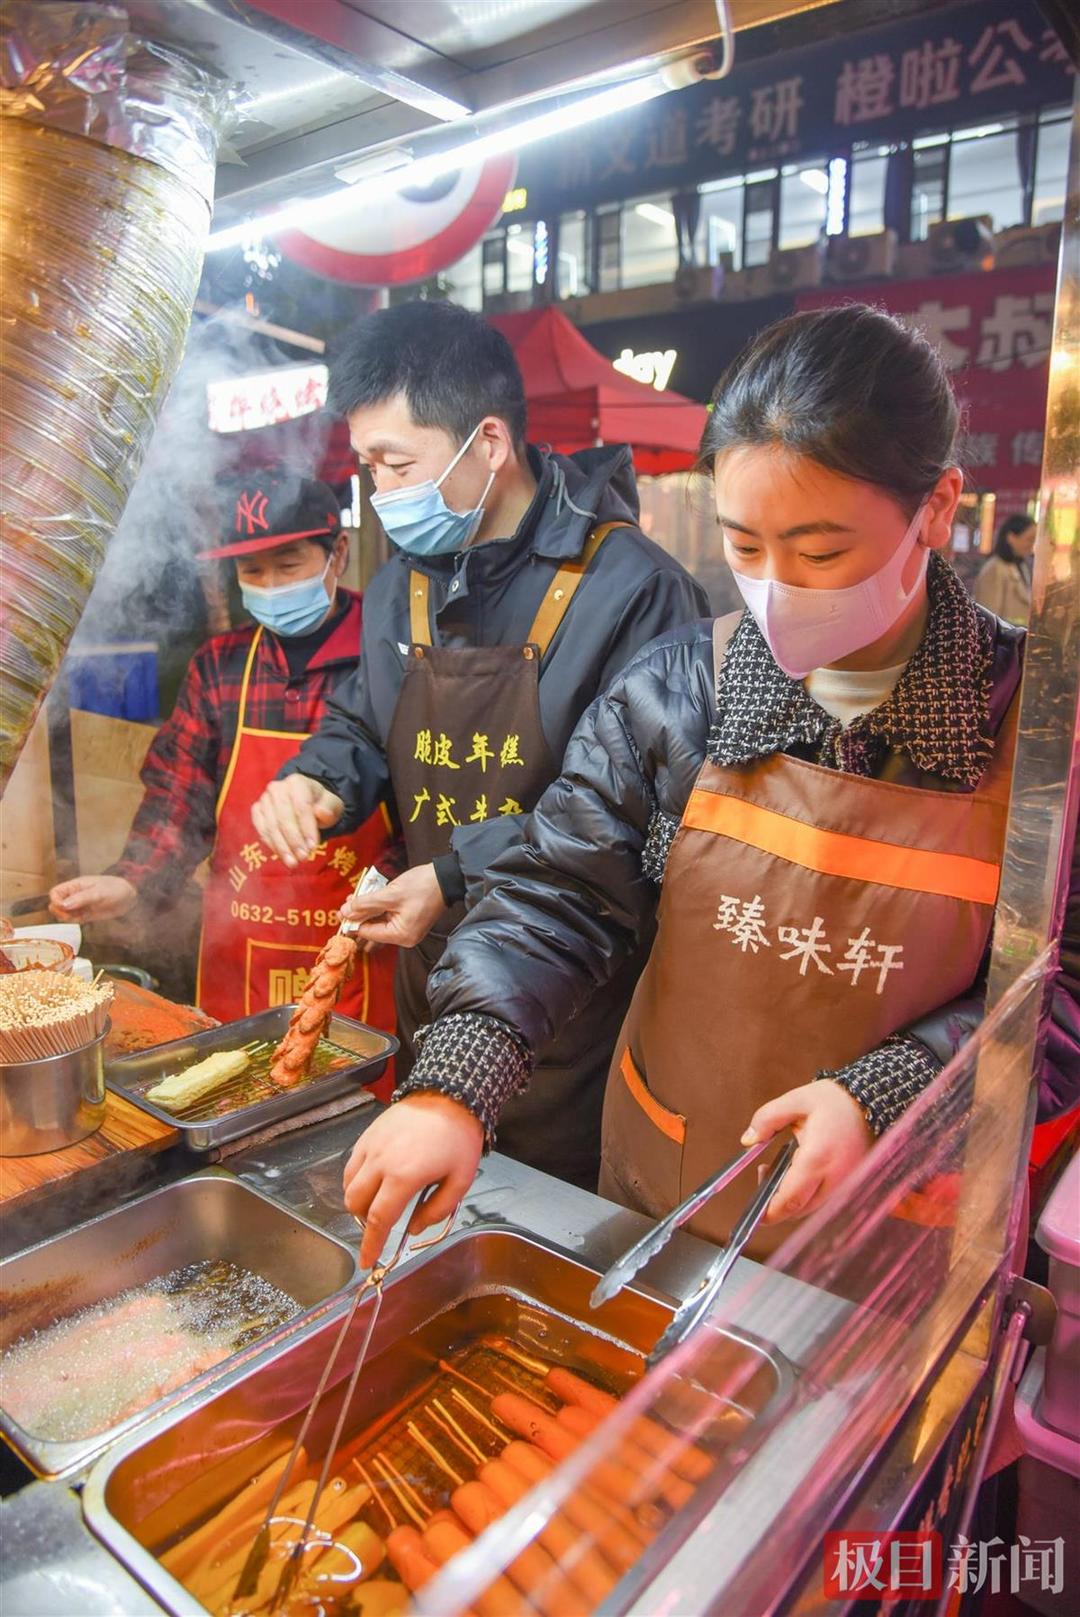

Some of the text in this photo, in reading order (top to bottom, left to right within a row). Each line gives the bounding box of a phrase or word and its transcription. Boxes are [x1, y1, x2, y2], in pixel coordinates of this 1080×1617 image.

[235, 490, 269, 534] NY
[413, 728, 524, 773] 脆皮年糕
[713, 894, 904, 995] 臻味轩
